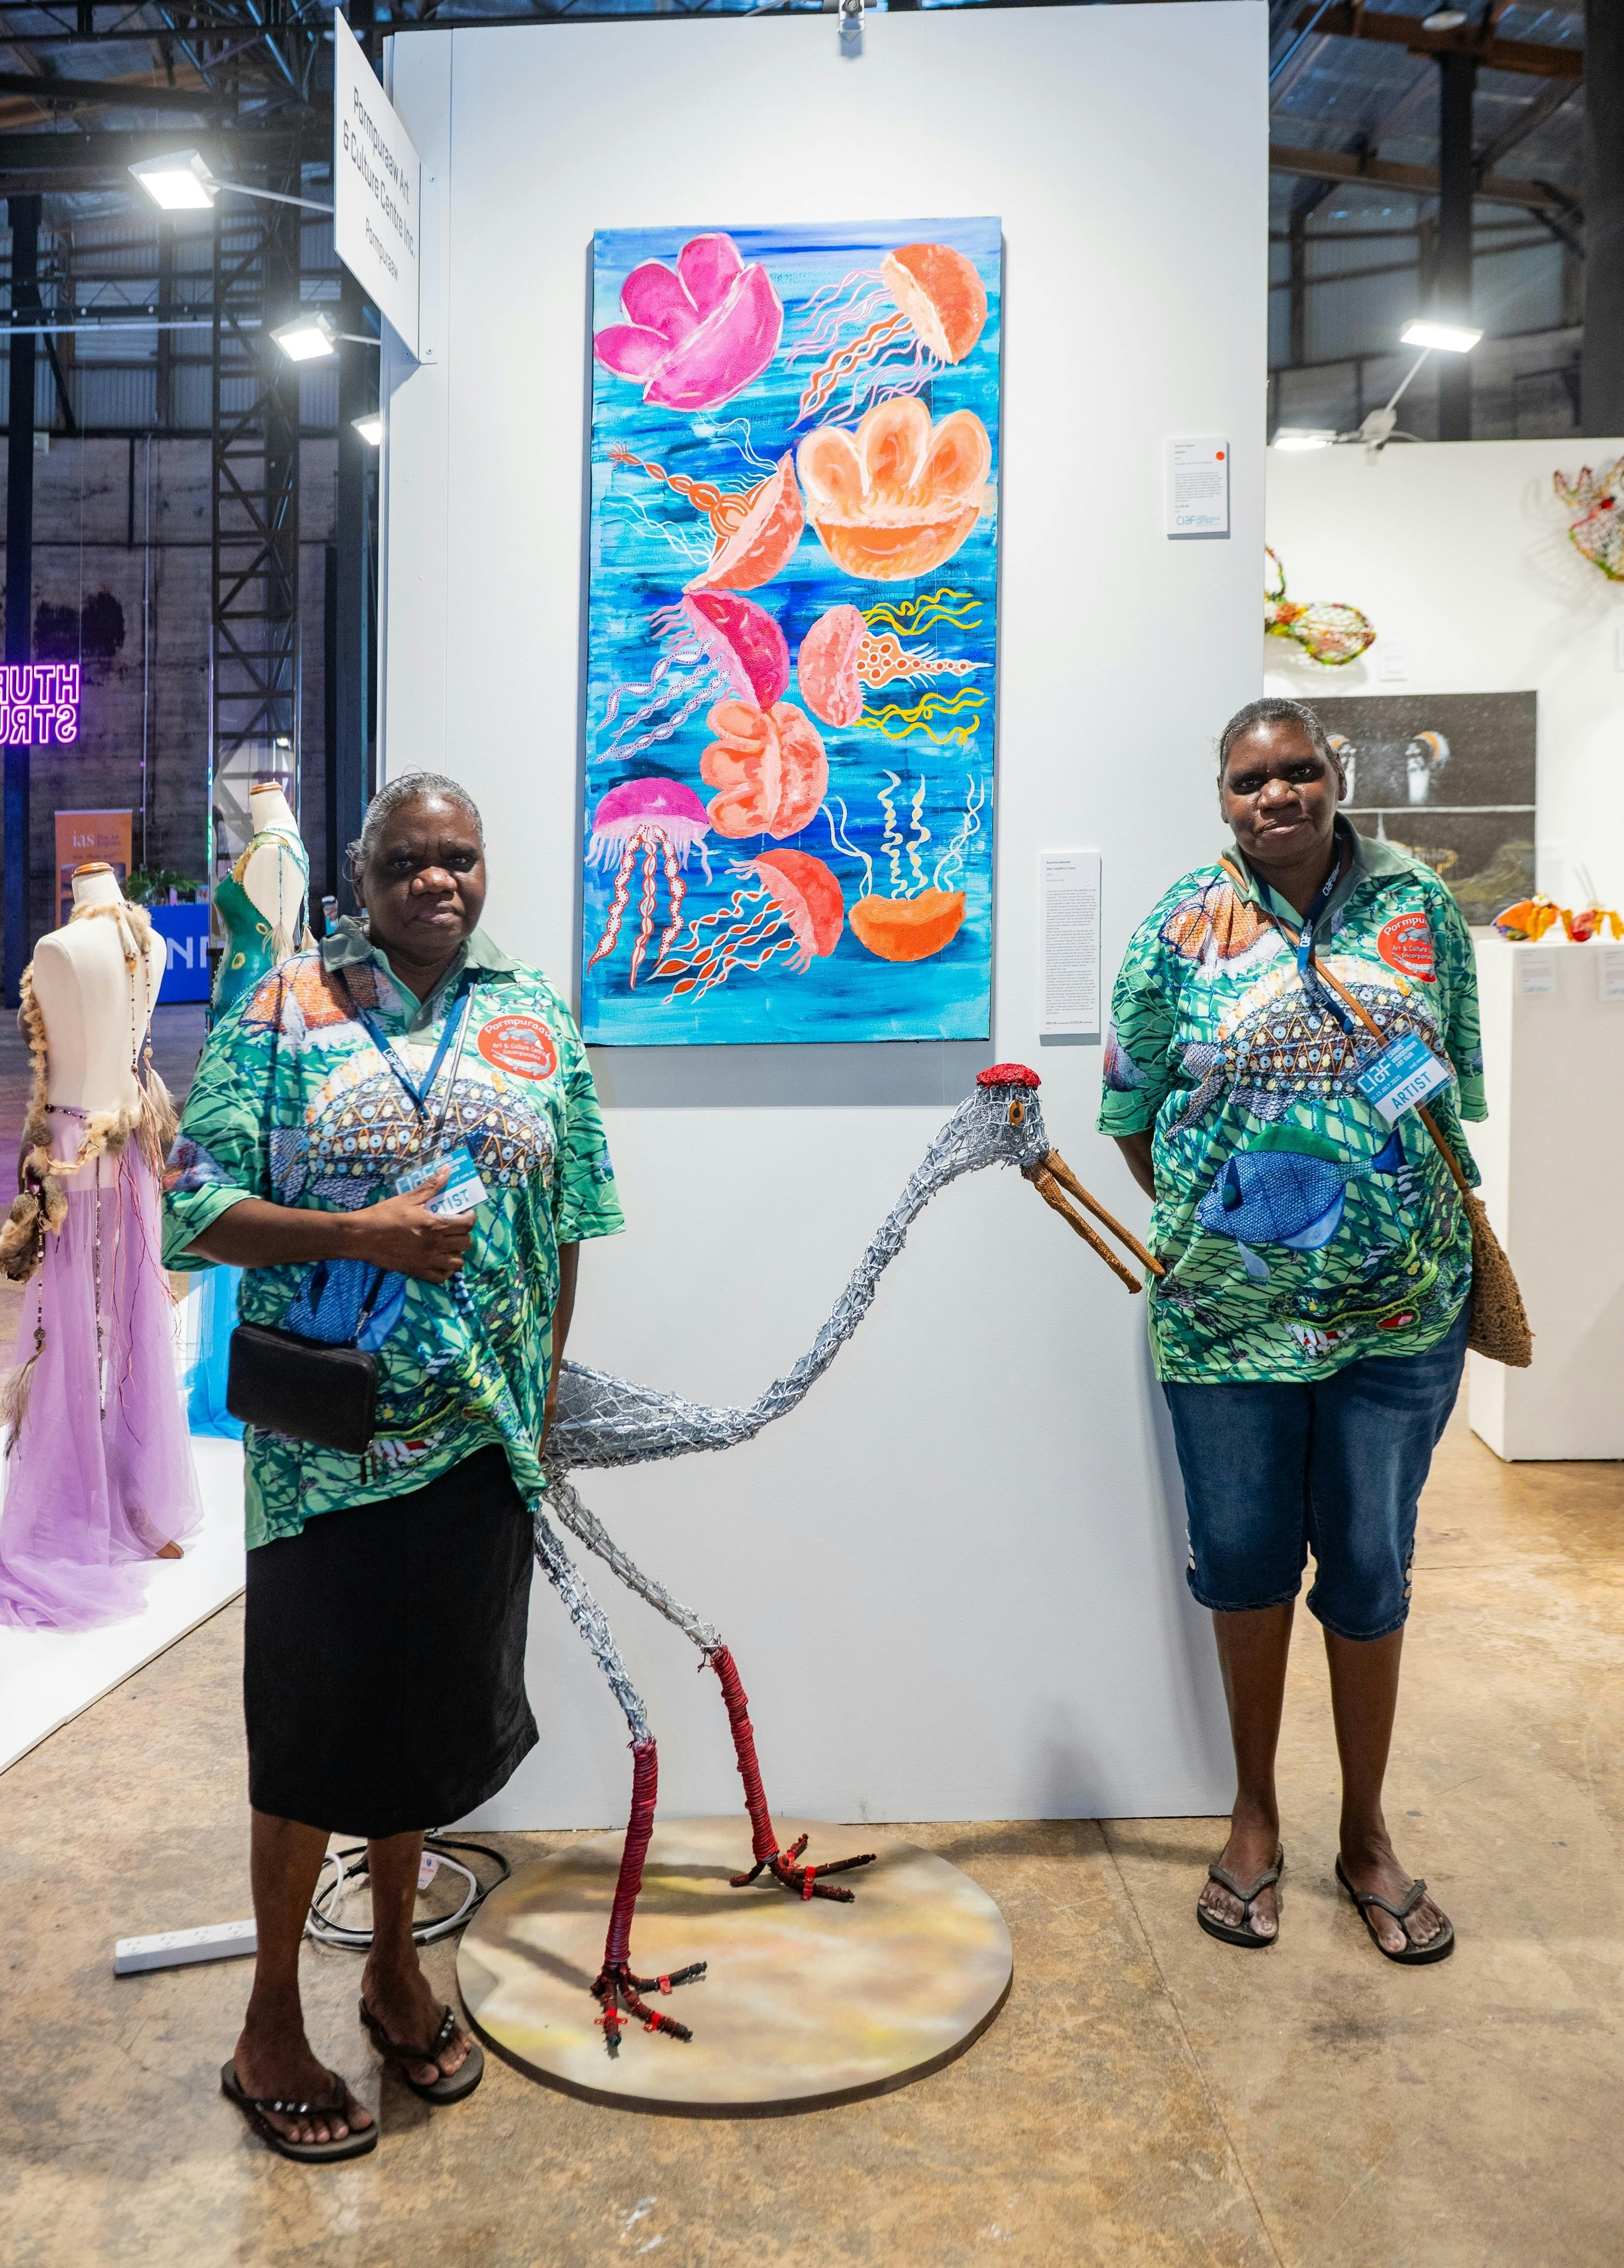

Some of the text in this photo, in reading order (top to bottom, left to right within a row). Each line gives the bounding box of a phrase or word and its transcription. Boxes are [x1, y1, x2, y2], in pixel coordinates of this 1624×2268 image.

[354, 85, 409, 205] Pormpuraaw Art
[351, 131, 379, 199] Culture
[381, 180, 402, 239] Centre
[404, 219, 415, 260] Inc.
[366, 217, 398, 282] Pormpuraaw
[1383, 917, 1426, 936] Pormpu
[484, 1018, 553, 1041] Pormpuraaw
[1381, 1082, 1391, 1093] JULY
[1391, 1071, 1432, 1110] ARTIST
[430, 1188, 469, 1214] RTIST
